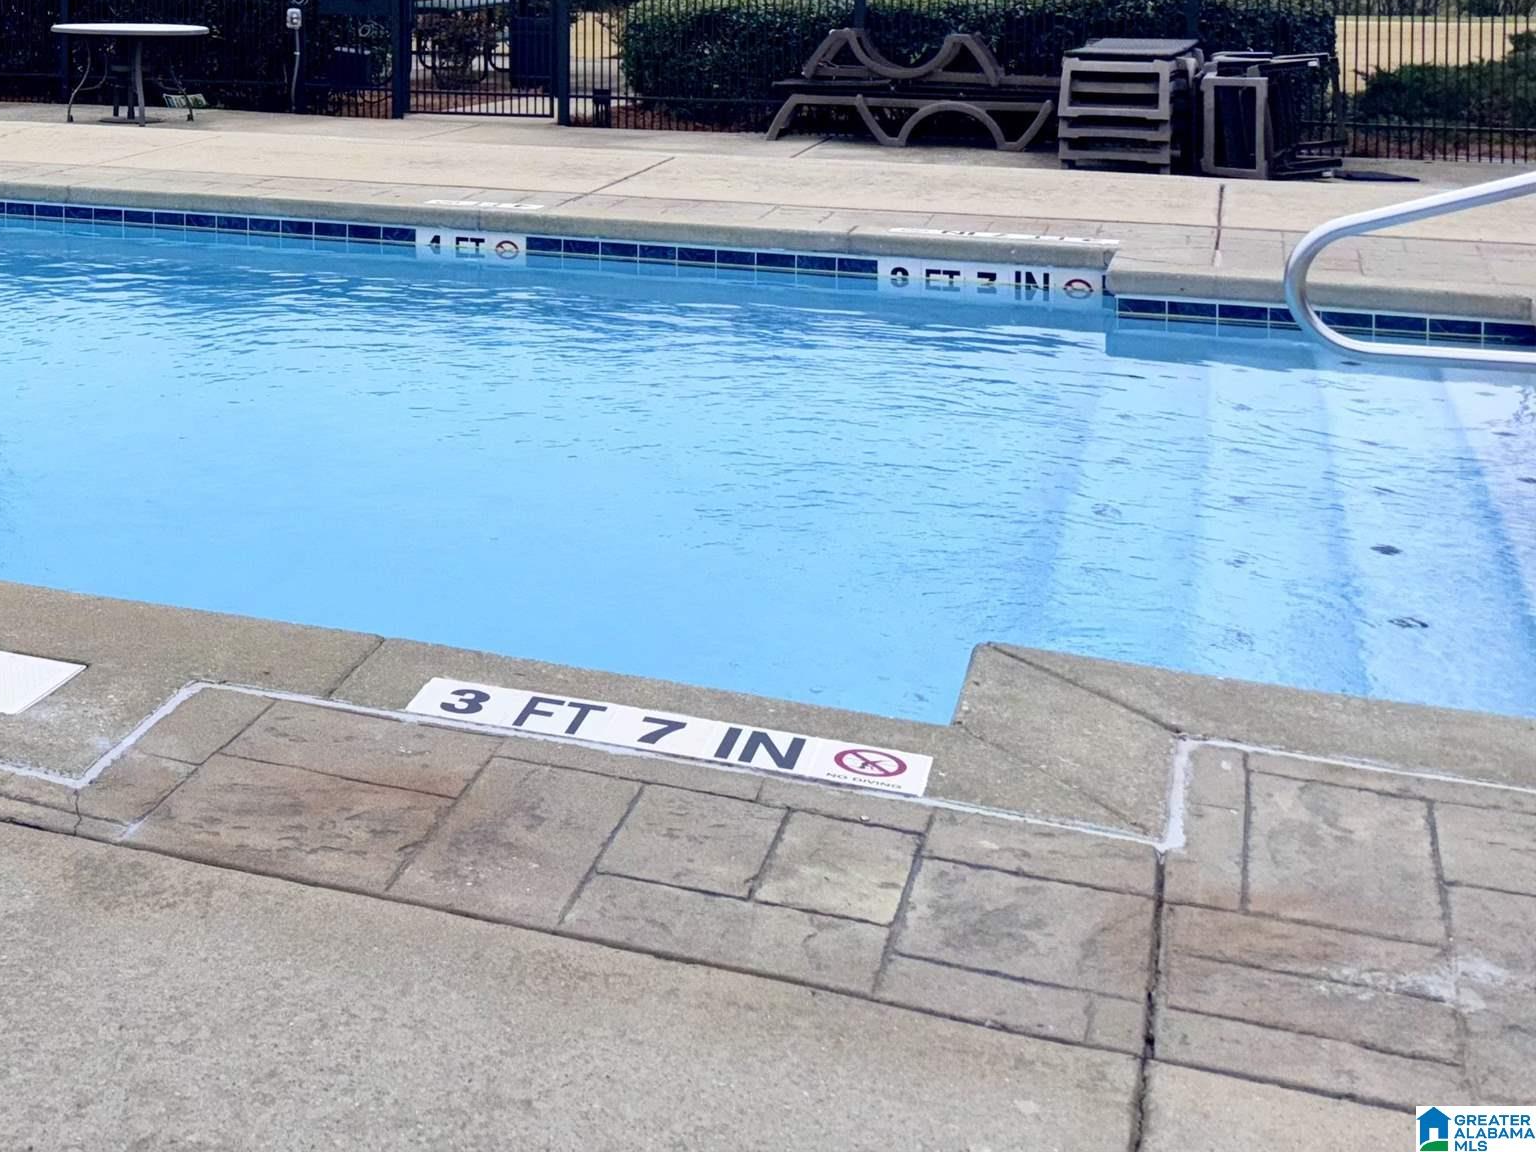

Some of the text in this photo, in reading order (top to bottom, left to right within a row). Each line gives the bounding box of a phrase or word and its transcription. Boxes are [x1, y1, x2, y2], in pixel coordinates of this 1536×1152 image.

[439, 689, 807, 770] 3 FT 7 IN
